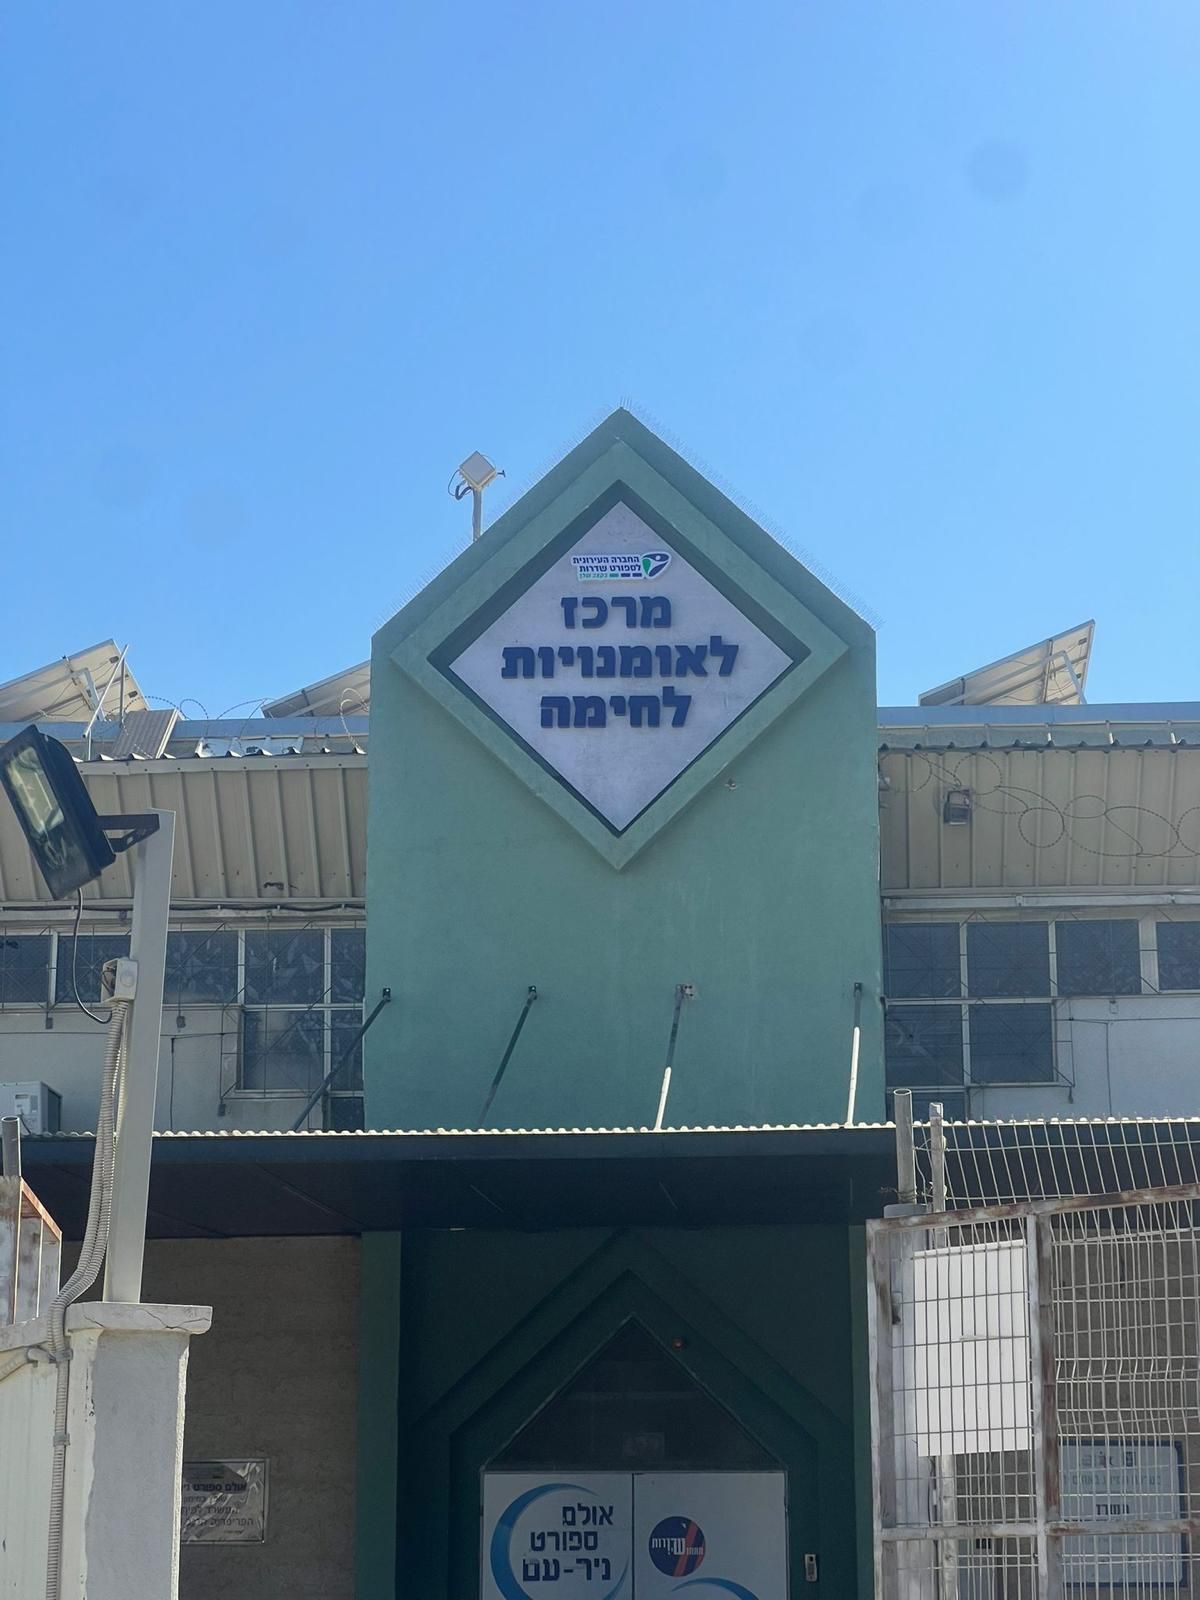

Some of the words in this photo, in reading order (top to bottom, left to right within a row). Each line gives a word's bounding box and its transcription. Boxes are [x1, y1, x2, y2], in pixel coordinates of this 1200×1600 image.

[572, 556, 609, 564] העירונית
[579, 565, 608, 573] שדרות
[609, 564, 641, 572] לספורט
[560, 596, 672, 630] מרכז
[501, 635, 739, 680] לאומנויות
[540, 686, 692, 729] לחימה
[562, 1502, 614, 1526] אולם
[530, 1531, 598, 1552] ספורט
[522, 1557, 611, 1582] ניר-עם
